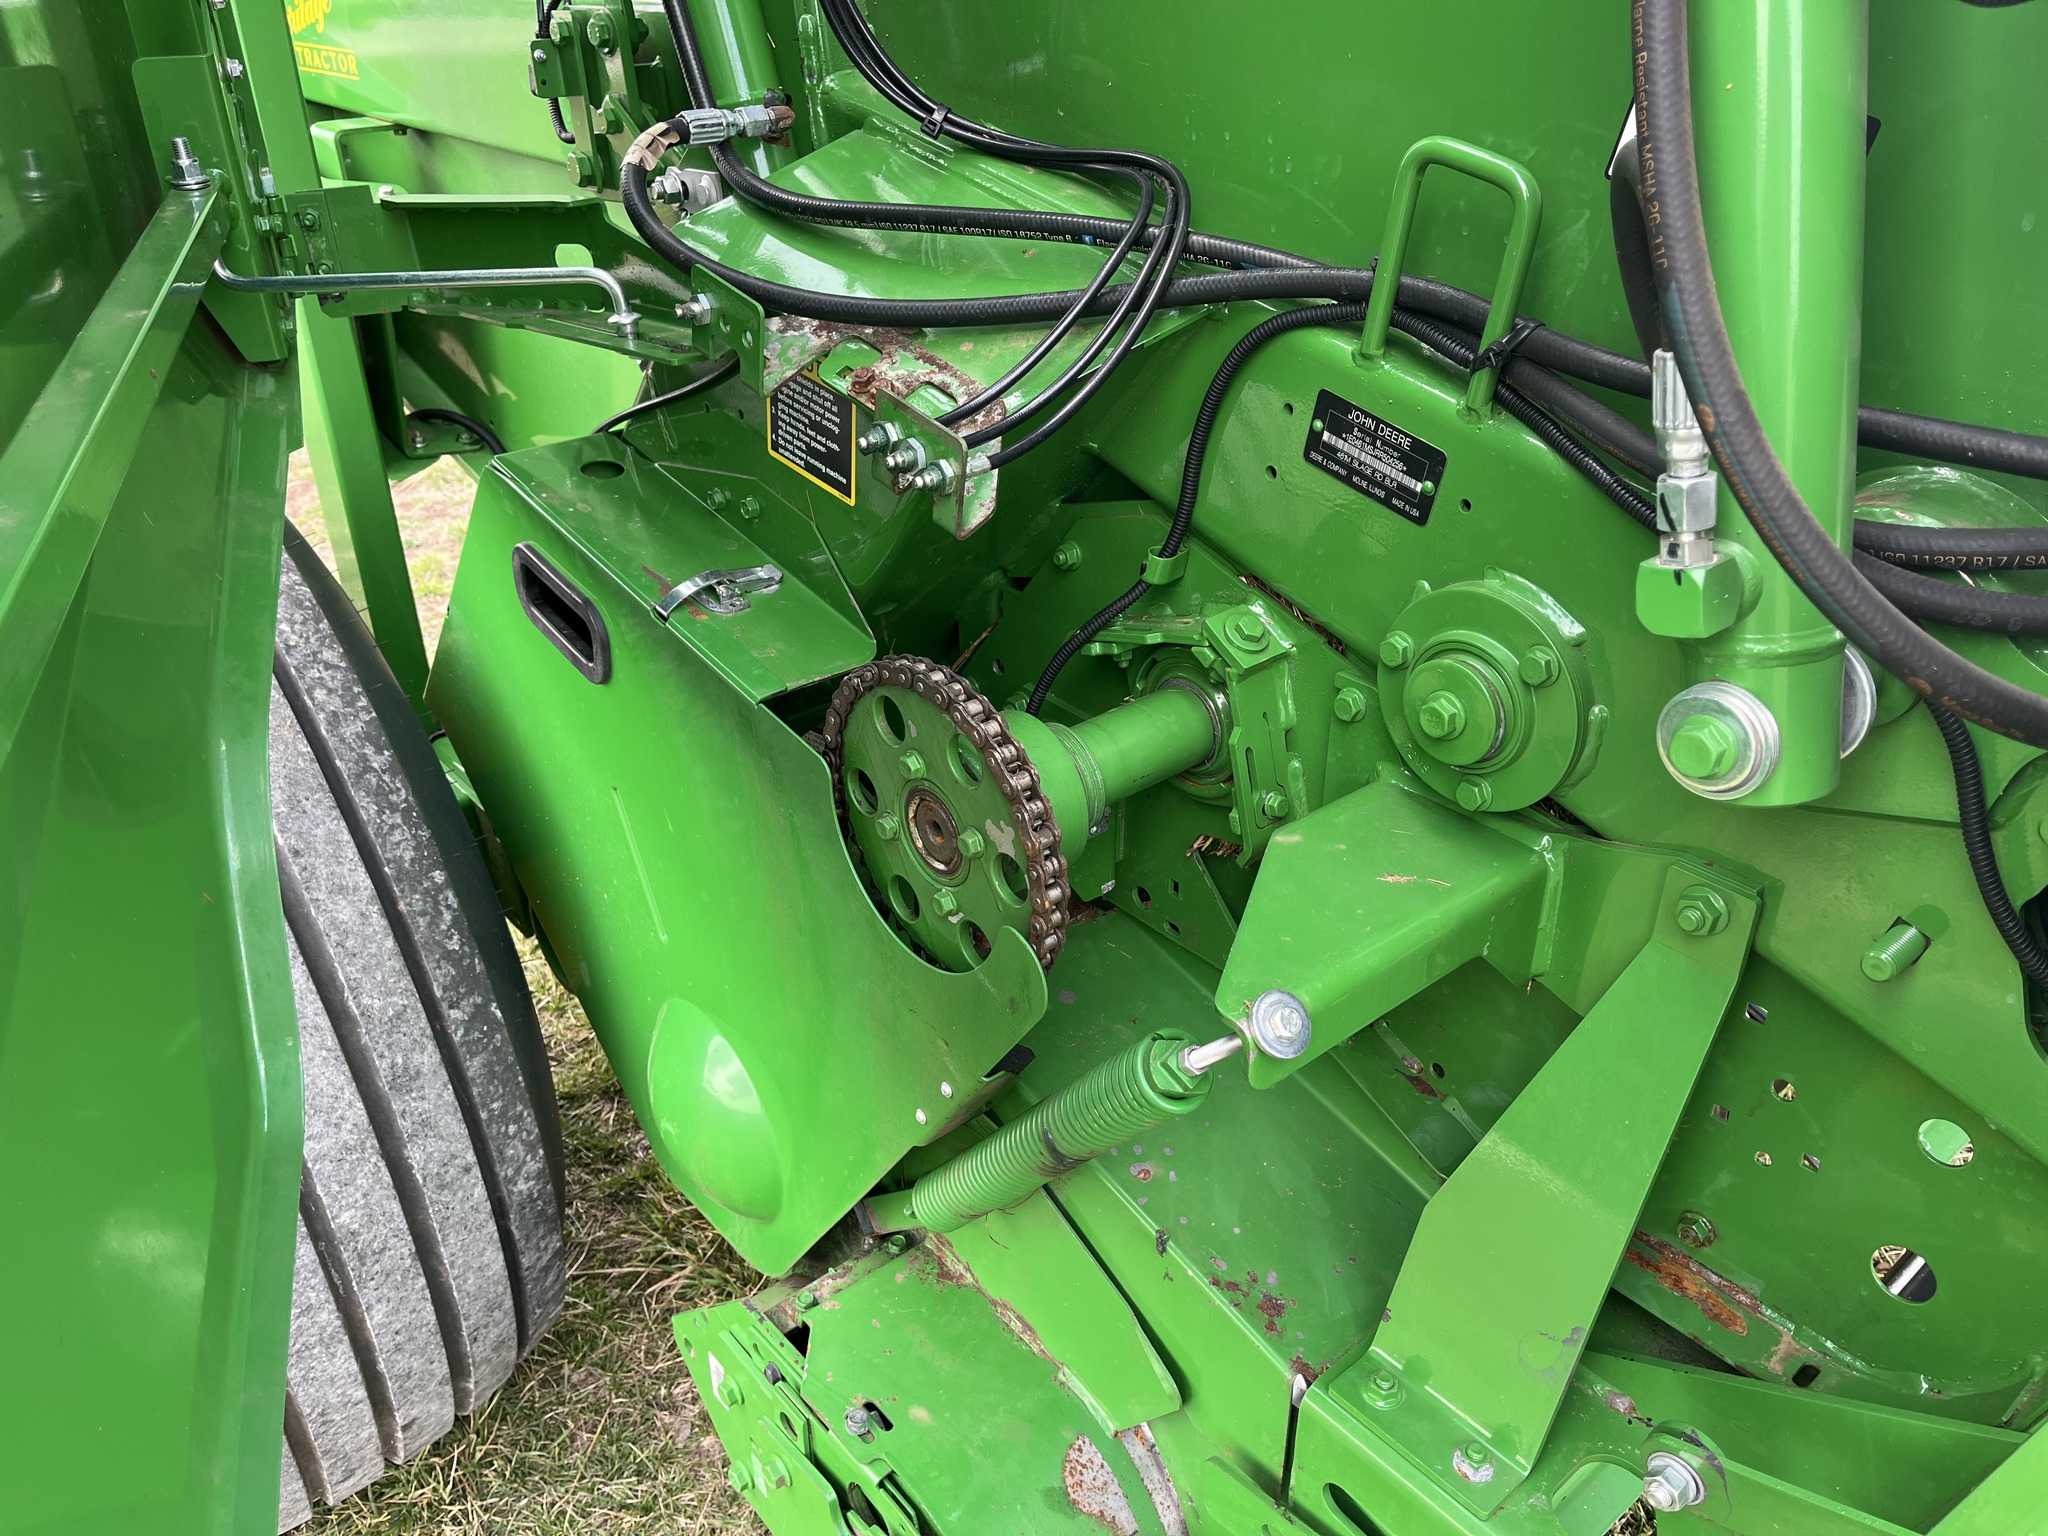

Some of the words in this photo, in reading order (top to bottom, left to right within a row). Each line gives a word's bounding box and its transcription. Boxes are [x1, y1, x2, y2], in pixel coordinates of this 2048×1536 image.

[1634, 0, 1645, 48] lame
[295, 47, 359, 75] TRACTOR
[1635, 51, 1650, 139] Resistant
[1641, 143, 1657, 198] MSHA
[920, 224, 935, 232] R17
[942, 226, 958, 234] SAE
[960, 227, 992, 236] 100R17
[997, 229, 1013, 237] ISO
[1014, 230, 1042, 239] 18752
[1647, 201, 1668, 271] 2G-11C
[1096, 238, 1118, 248] Flam
[1196, 255, 1232, 269] 2G-11C
[1348, 409, 1376, 431] JOHN
[1377, 423, 1412, 450] DEERE
[1352, 427, 1373, 443] Serial
[1375, 439, 1401, 458] Number
[1327, 460, 1349, 477] COMPANY
[1391, 497, 1404, 510] MADE
[1409, 506, 1420, 518] USA
[1912, 554, 1967, 568] 11237
[1973, 556, 2009, 568] R17
[2024, 555, 2048, 567] SA
